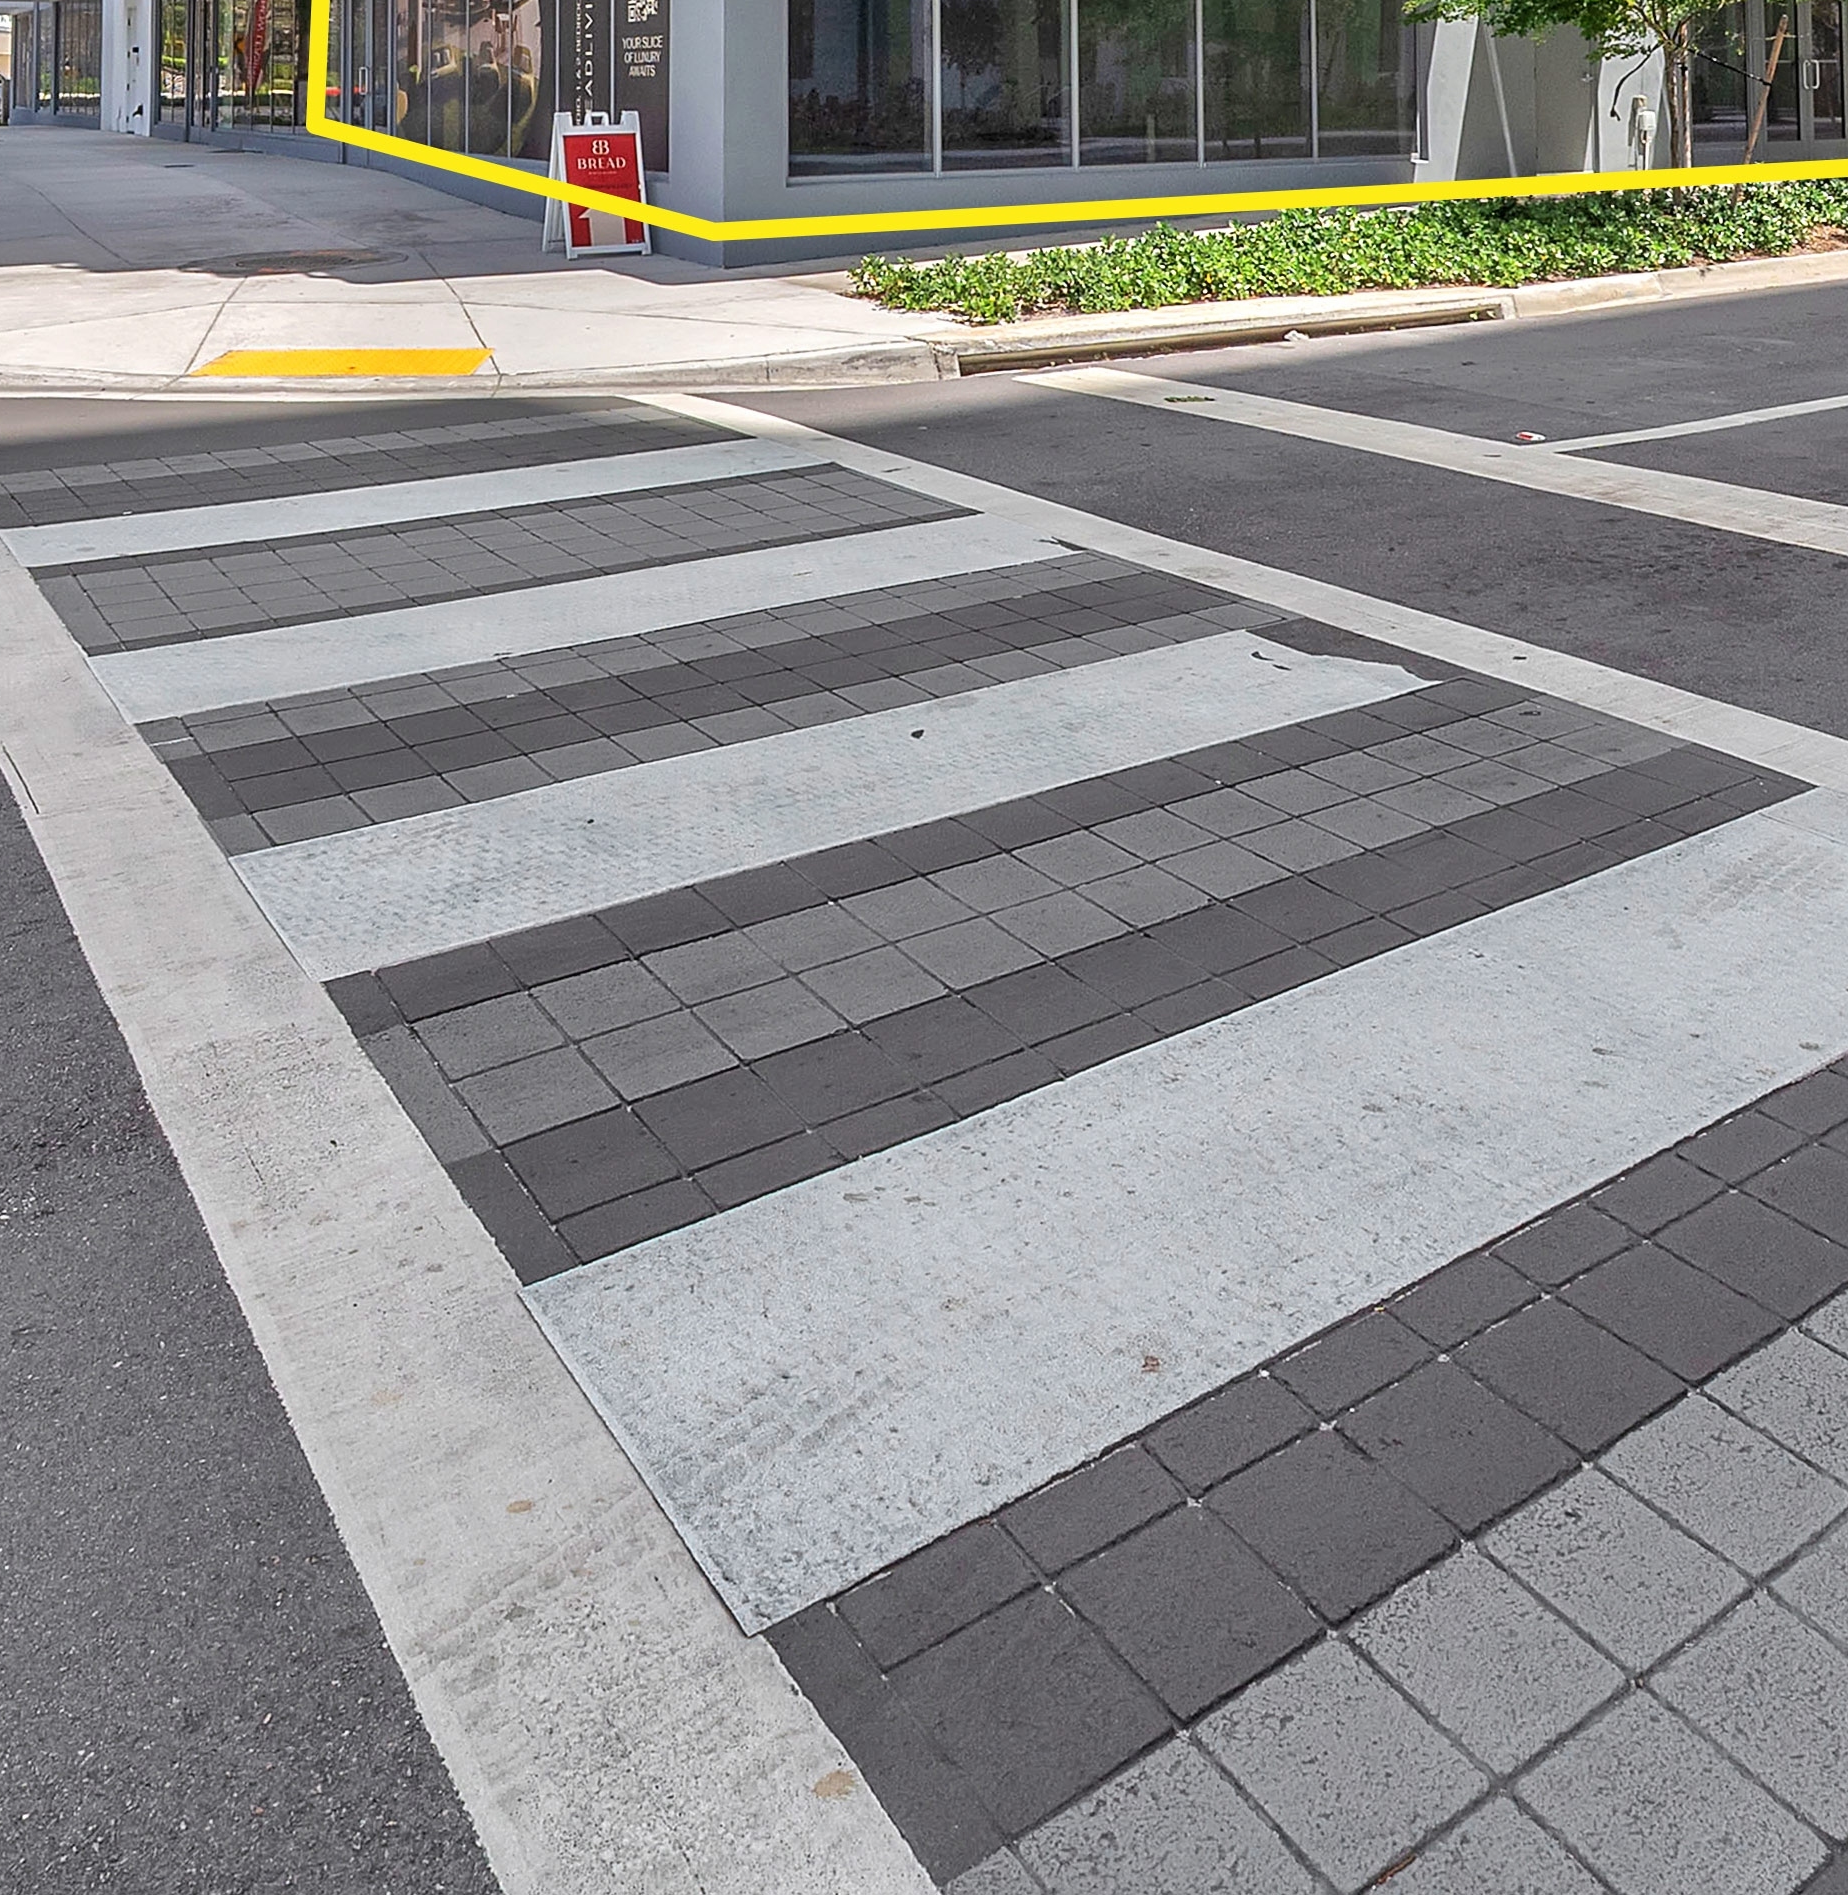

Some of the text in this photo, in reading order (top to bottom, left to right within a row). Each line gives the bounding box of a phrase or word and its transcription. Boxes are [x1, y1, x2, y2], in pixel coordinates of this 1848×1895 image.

[622, 35, 663, 49] YOUR SLICE
[624, 50, 661, 63] OF LUXURY
[628, 64, 656, 77] AWAITS
[577, 156, 626, 170] BREAD
